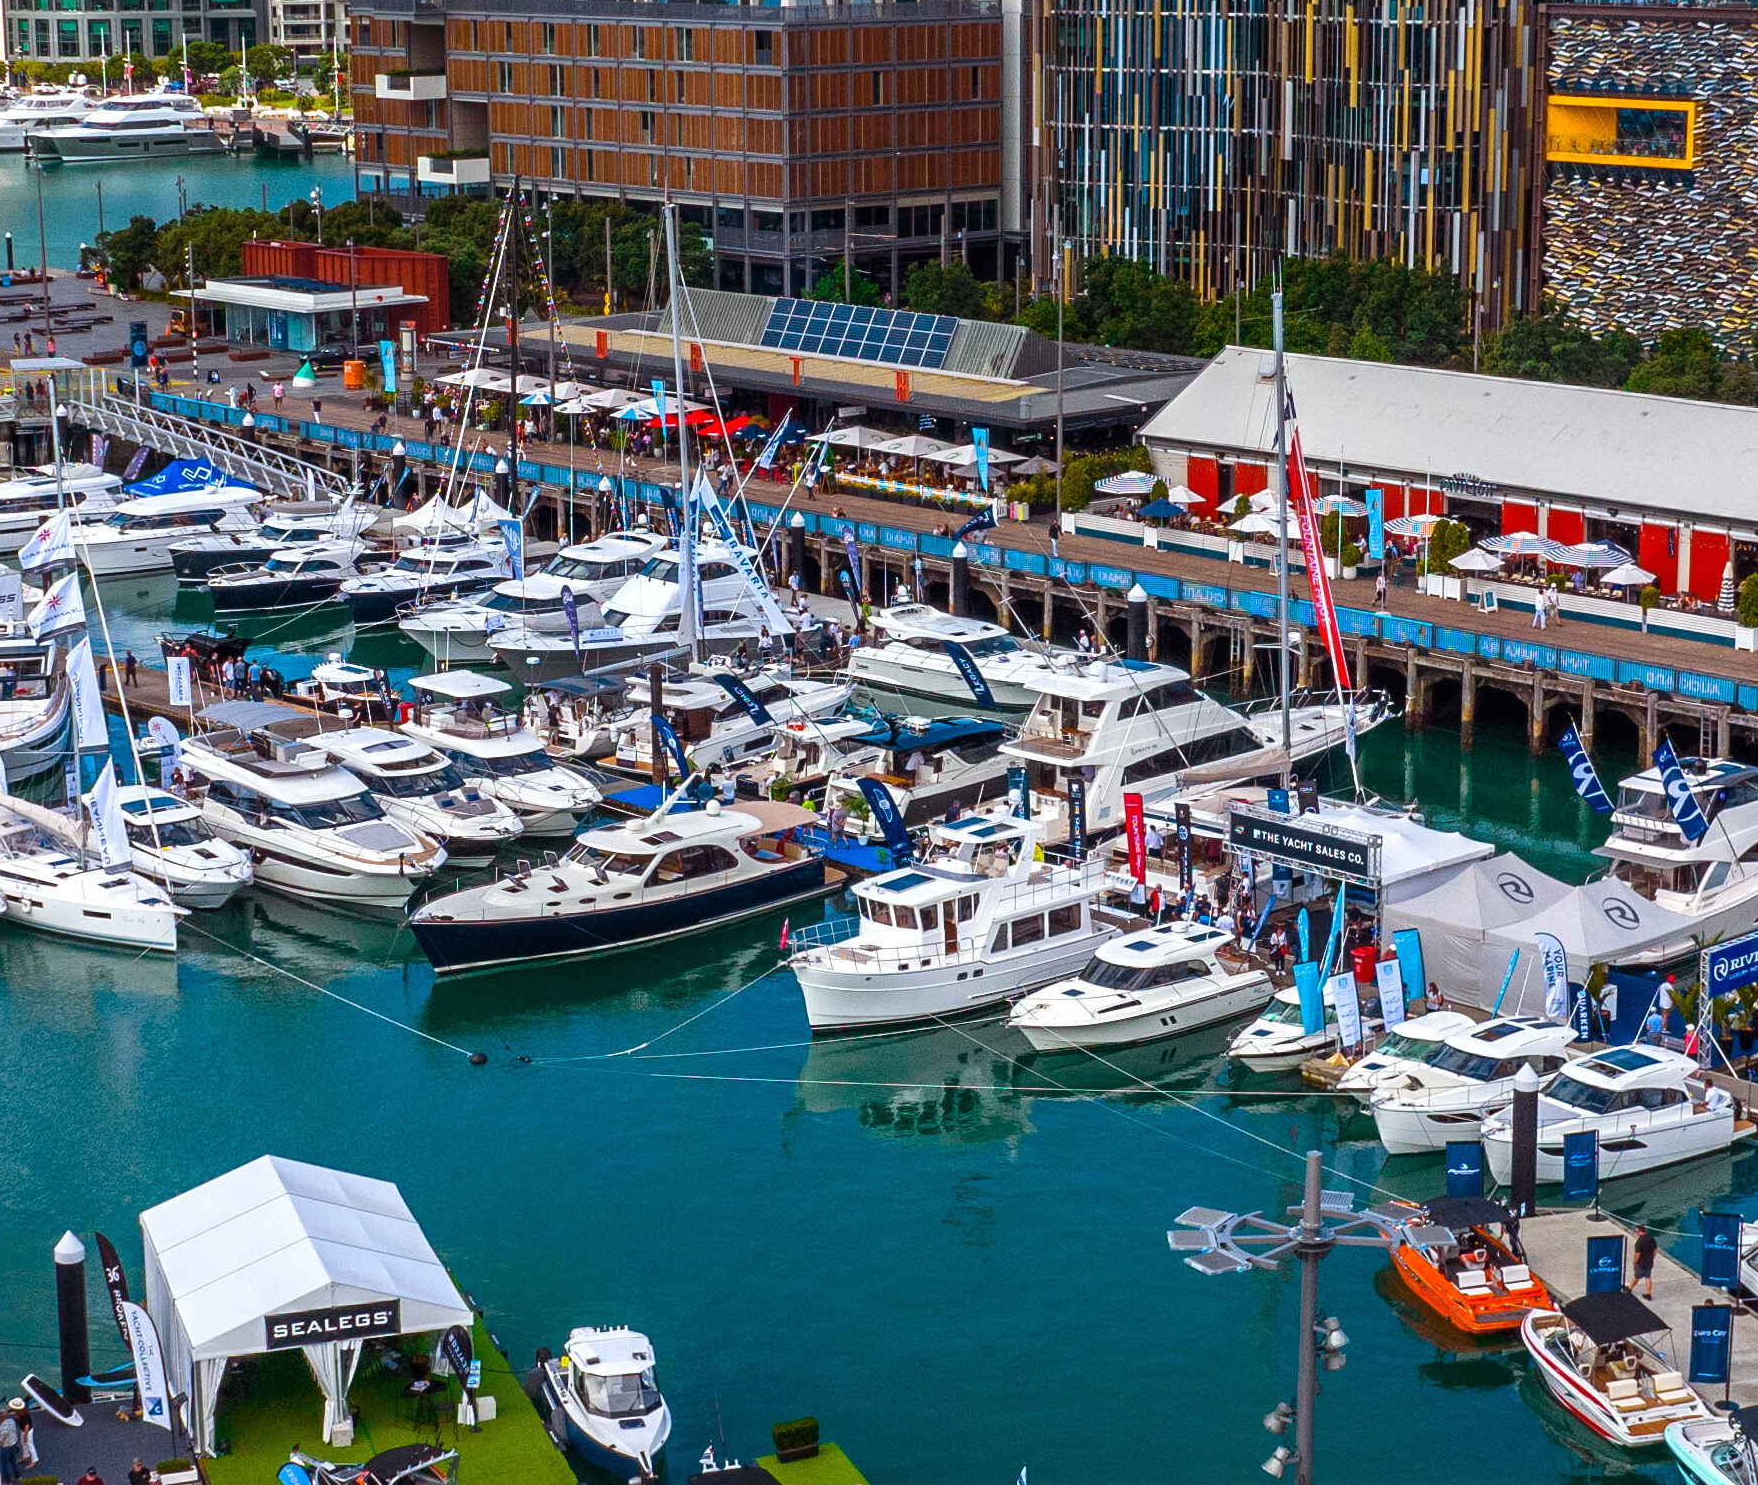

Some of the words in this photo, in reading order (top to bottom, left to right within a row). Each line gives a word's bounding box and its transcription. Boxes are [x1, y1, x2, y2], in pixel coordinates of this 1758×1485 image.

[728, 537, 770, 600] BAVARIA
[1262, 829, 1280, 846] THE
[1282, 834, 1313, 854] YACHT
[1315, 843, 1346, 862] SALES
[1347, 851, 1365, 865] CO.
[1543, 951, 1556, 988] MARINE
[1554, 947, 1565, 978] YOUR
[1577, 991, 1589, 1040] QUARKEN
[272, 1310, 389, 1339] SEALEGS
